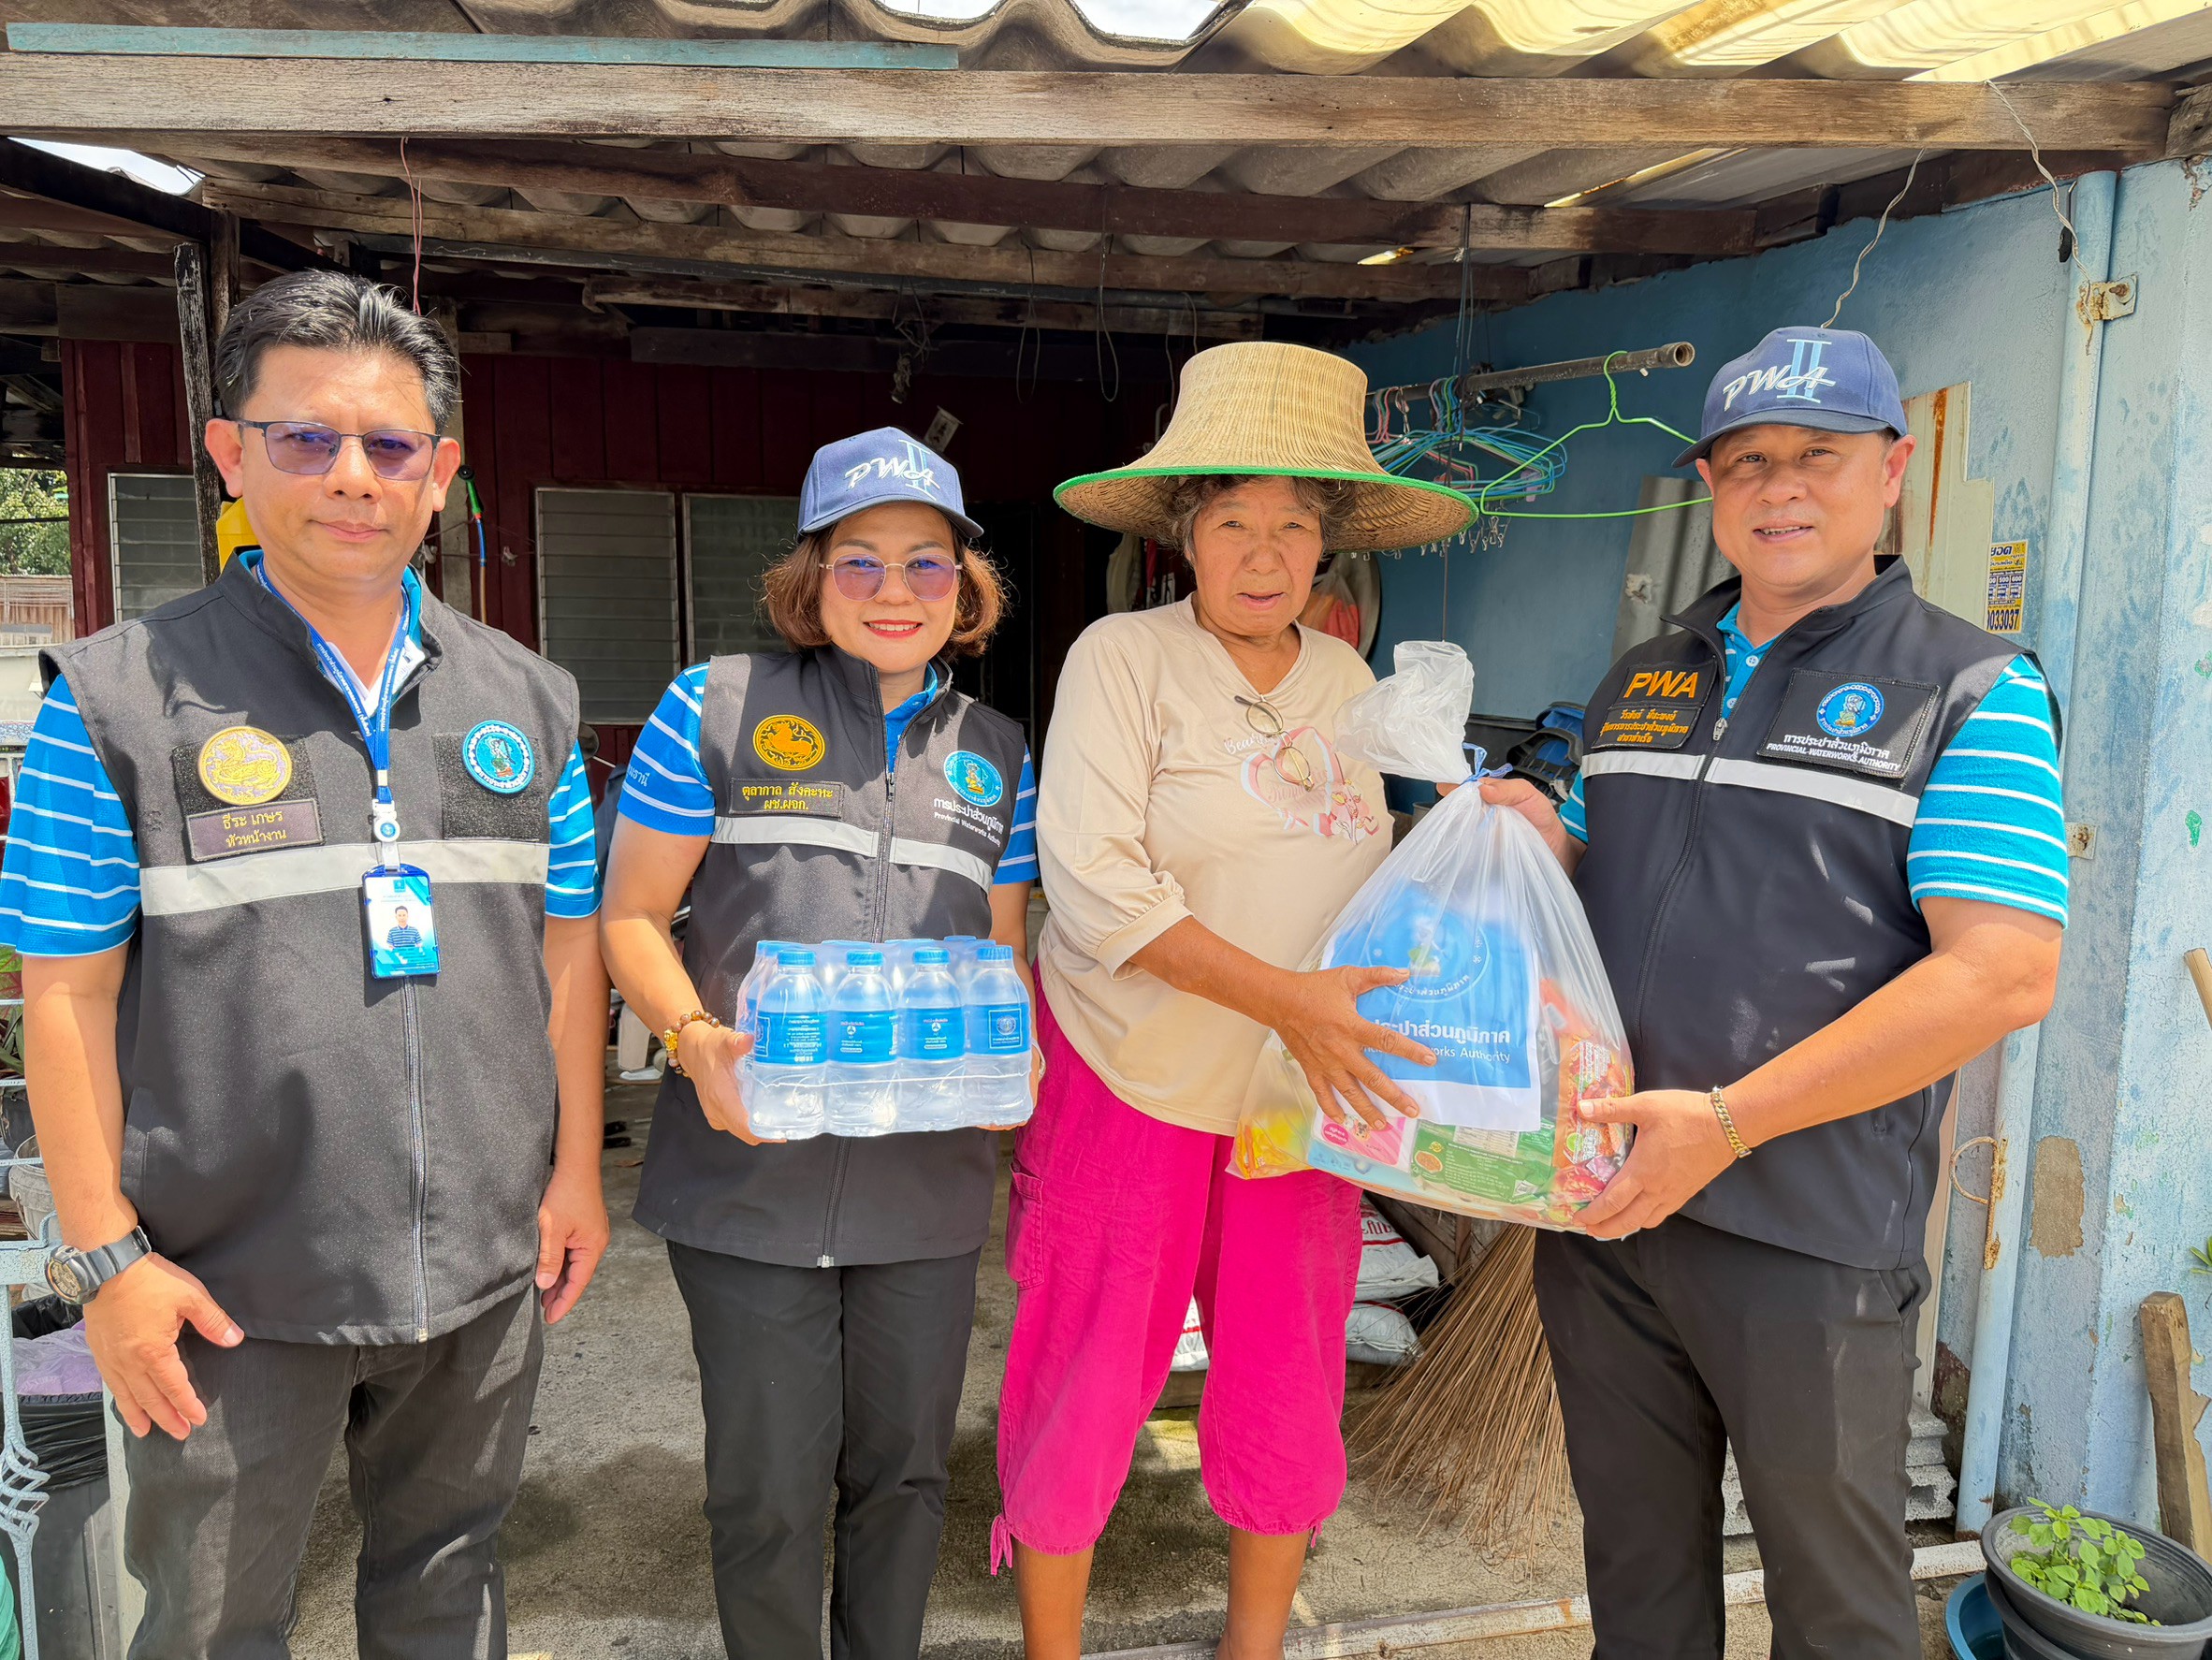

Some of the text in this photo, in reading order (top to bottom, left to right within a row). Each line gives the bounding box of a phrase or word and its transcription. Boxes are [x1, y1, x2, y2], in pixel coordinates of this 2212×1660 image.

[1723, 365, 1836, 412] PWA
[844, 457, 940, 491] PWA
[1623, 671, 1698, 698] PWA
[1766, 743, 1901, 771] PROVINCIAL WATERWORKS AUTHORITY
[1783, 735, 1890, 760] การประปาส่วนภูมิภาค
[223, 810, 284, 829] ธีระ เกษร
[934, 797, 1004, 835] การประปาส่วนภูมิภาค
[226, 829, 287, 848] หัวหน้างาน
[1432, 1045, 1510, 1064] orks Authority
